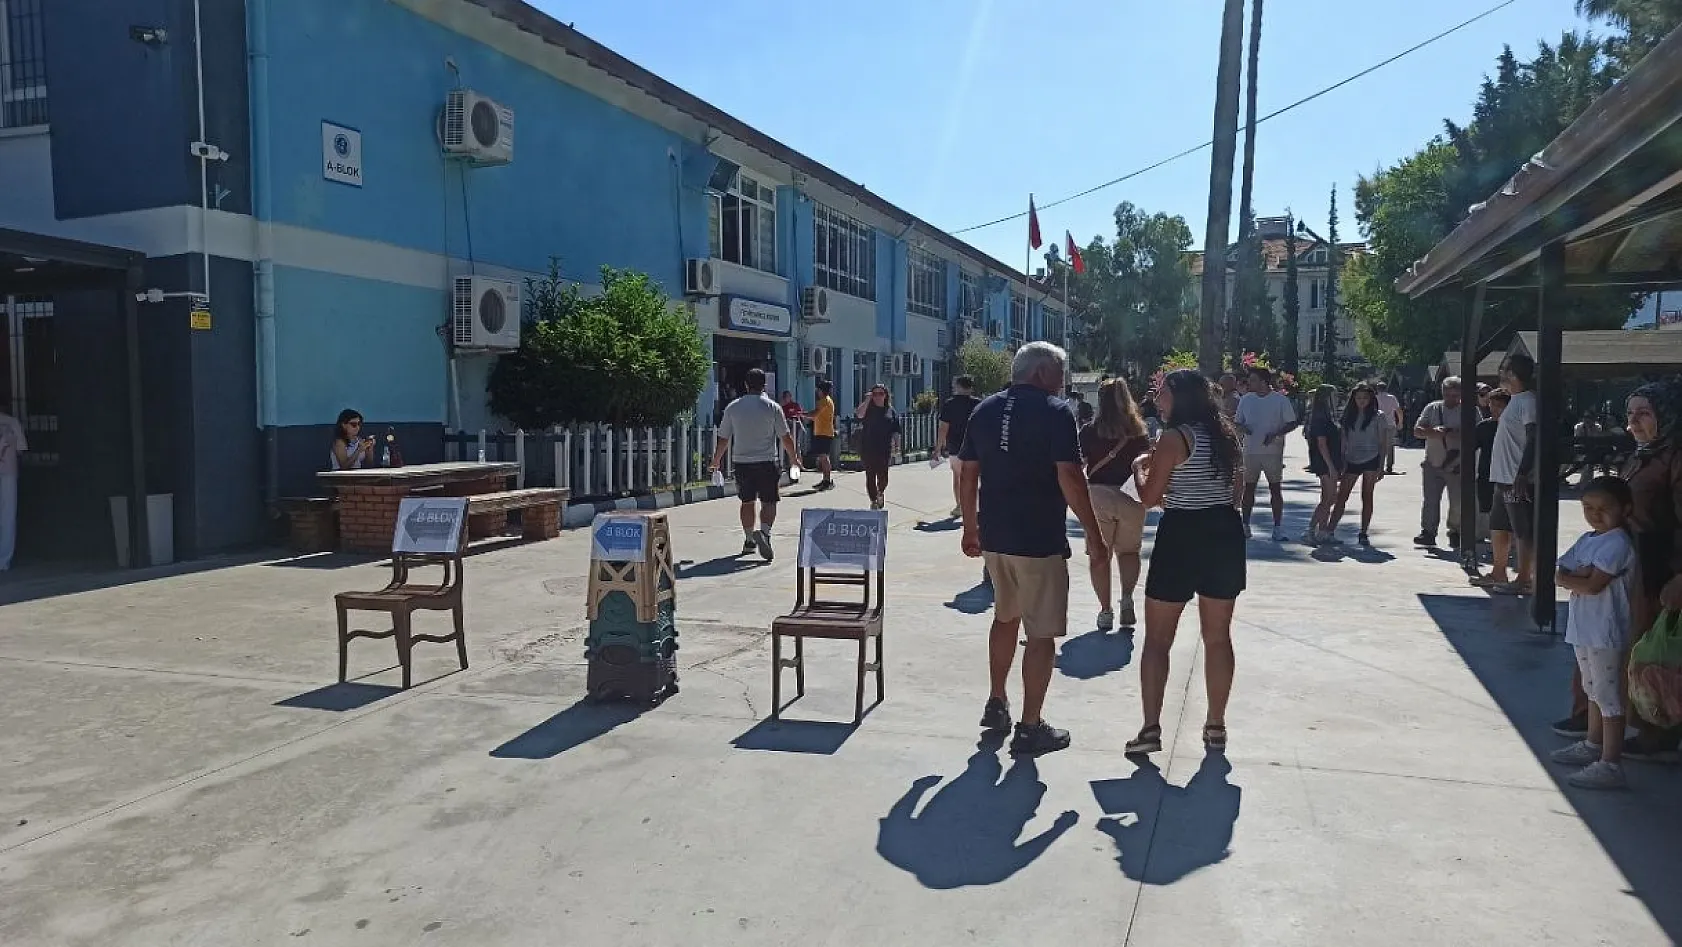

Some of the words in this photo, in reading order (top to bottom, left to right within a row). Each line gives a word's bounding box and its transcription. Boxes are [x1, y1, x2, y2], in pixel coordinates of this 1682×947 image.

[327, 160, 360, 178] A-BLOK
[426, 511, 457, 523] BLOK
[615, 526, 641, 538] BLOK
[828, 522, 837, 535] B
[840, 523, 878, 538] BLOK
